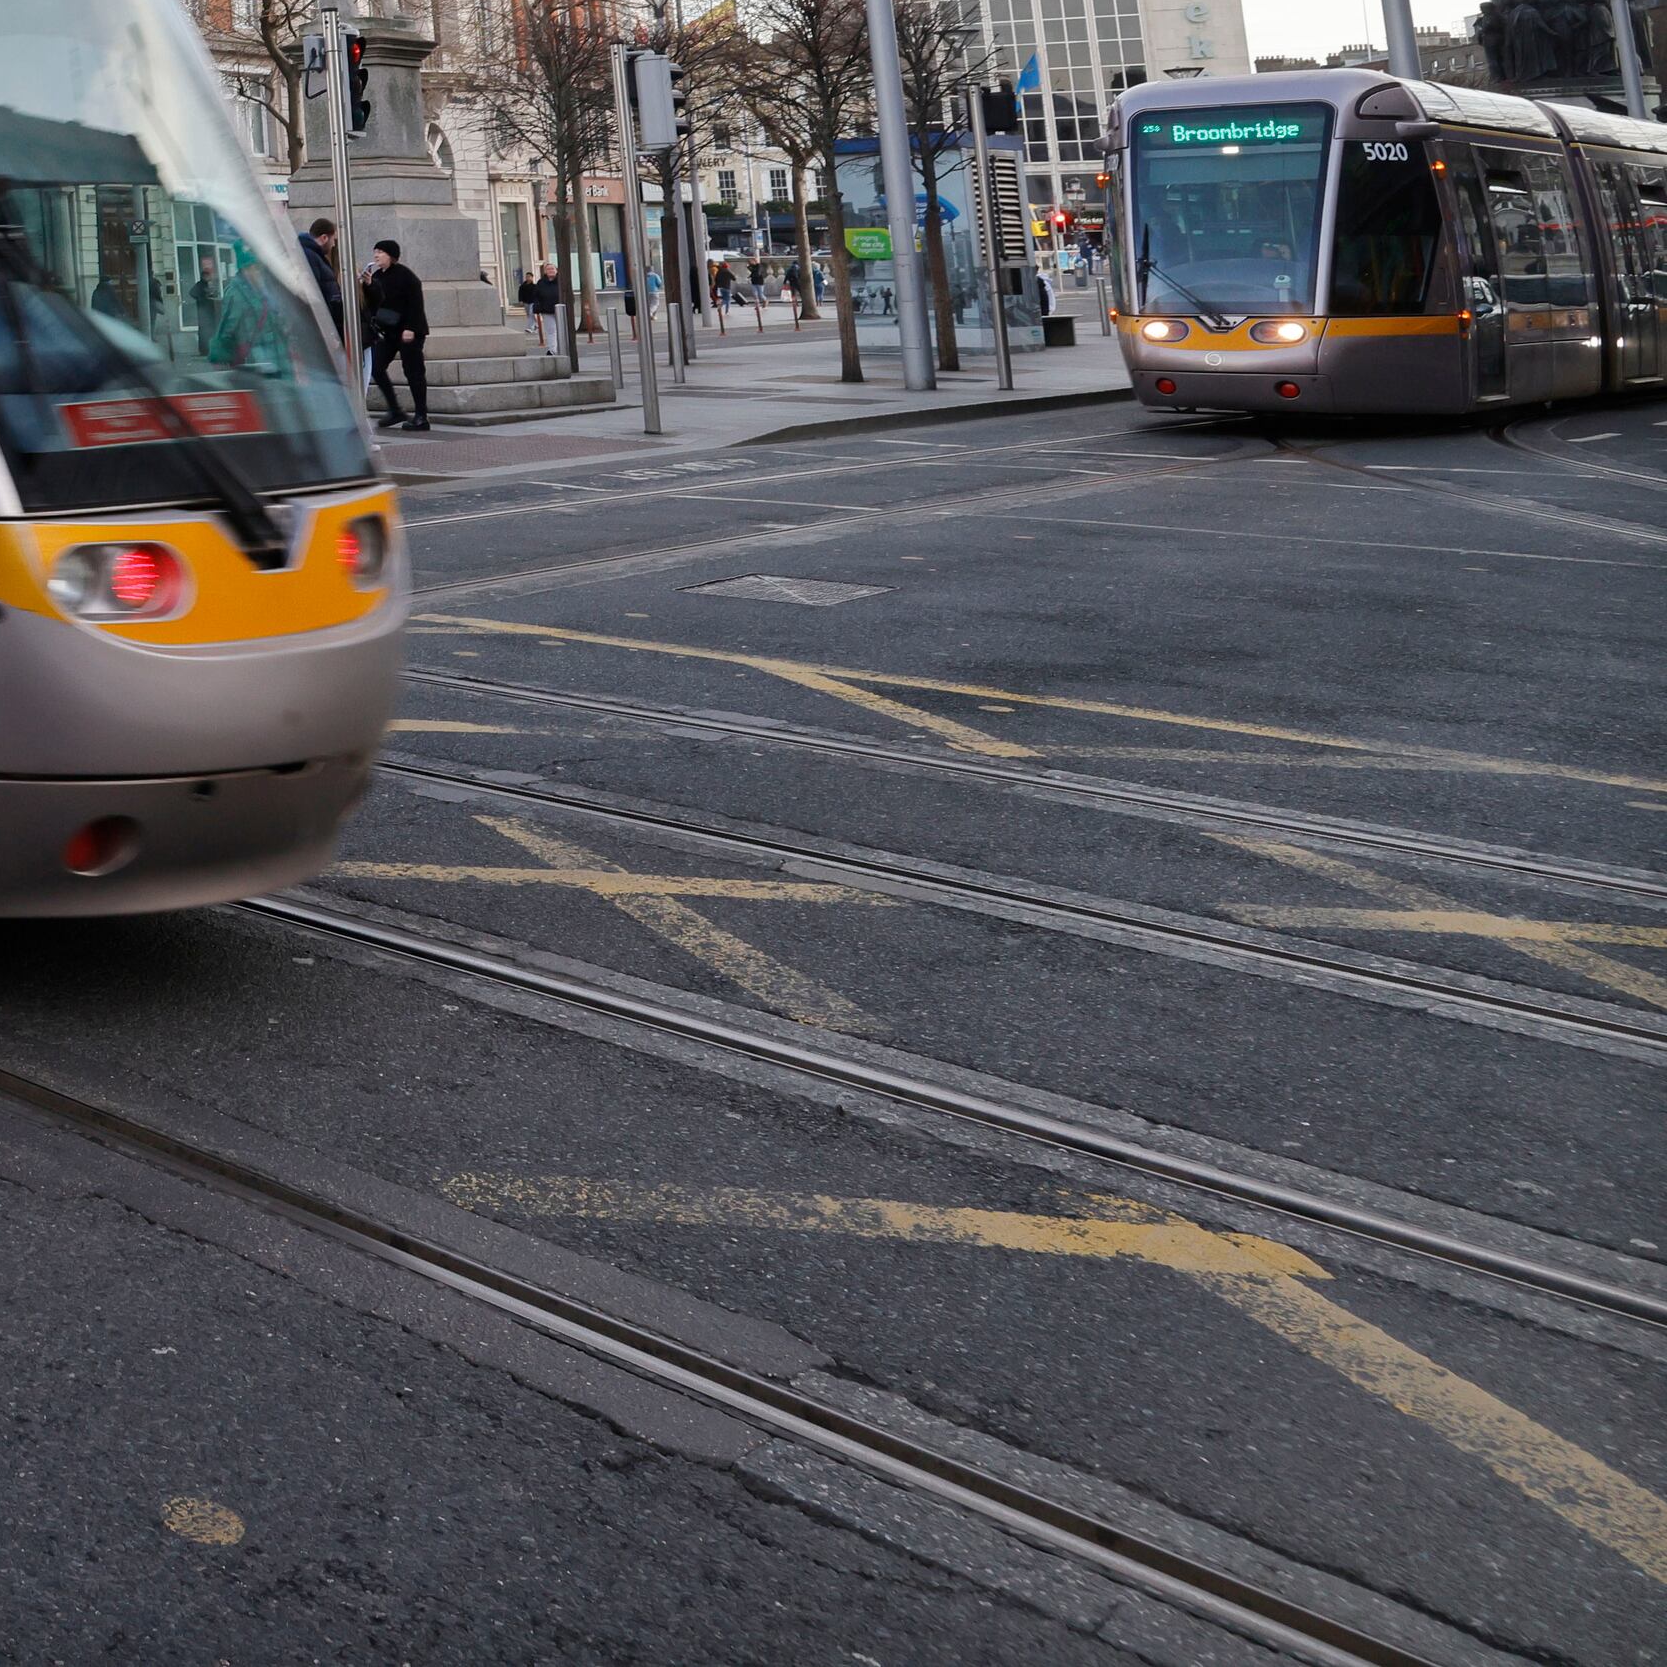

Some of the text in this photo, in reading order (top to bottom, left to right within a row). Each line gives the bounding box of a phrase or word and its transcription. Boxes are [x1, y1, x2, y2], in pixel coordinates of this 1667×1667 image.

[1172, 121, 1300, 142] Broombridge
[1363, 142, 1408, 162] 5020
[593, 184, 610, 197] Bank
